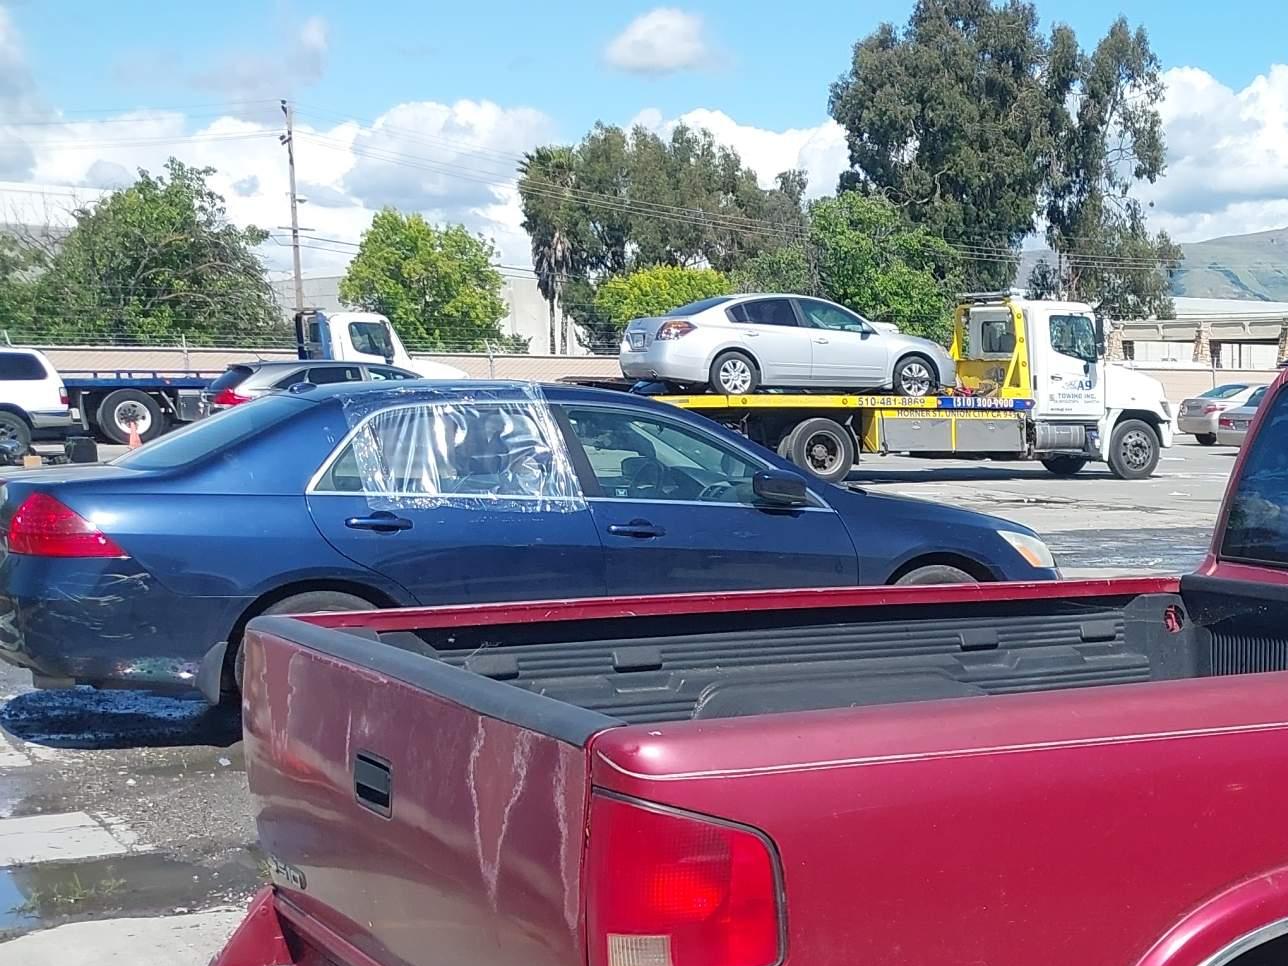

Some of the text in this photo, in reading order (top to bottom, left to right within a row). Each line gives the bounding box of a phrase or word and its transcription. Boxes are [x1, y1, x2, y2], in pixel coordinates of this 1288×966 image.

[1077, 380, 1093, 391] A9
[858, 397, 926, 407] 510-481-8869
[953, 397, 976, 408] (510)
[897, 410, 932, 418] HORNER
[946, 411, 972, 419] UNION
[973, 411, 991, 419] CITY
[992, 411, 1002, 419] CA
